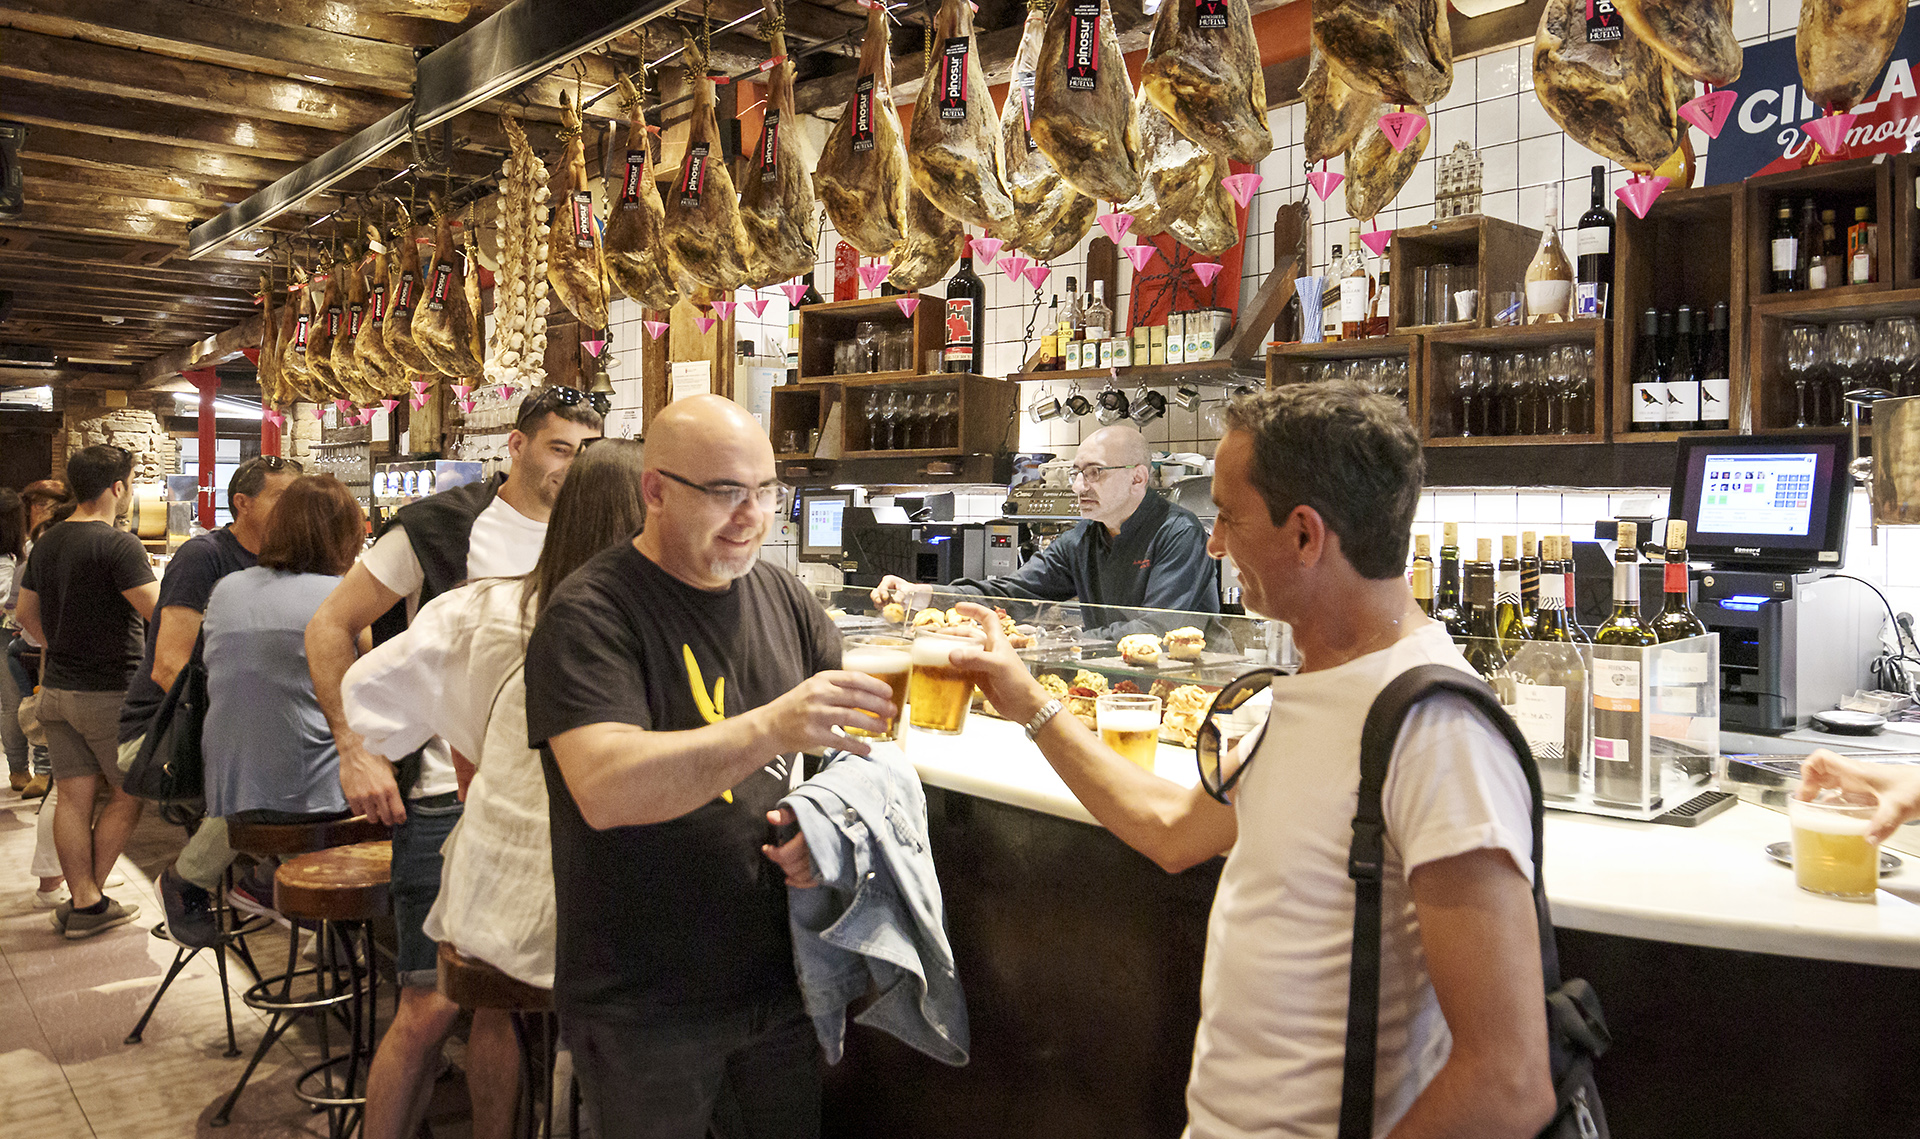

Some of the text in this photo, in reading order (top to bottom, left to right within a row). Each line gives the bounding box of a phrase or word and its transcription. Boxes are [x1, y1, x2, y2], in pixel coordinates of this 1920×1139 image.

[1076, 19, 1091, 66] pinosur
[947, 56, 960, 97] pinosur
[857, 94, 869, 132] pinosur
[764, 128, 774, 164] pinosur
[628, 165, 638, 195] pinosur
[688, 157, 700, 191] pinosur
[580, 204, 590, 234] pinosur
